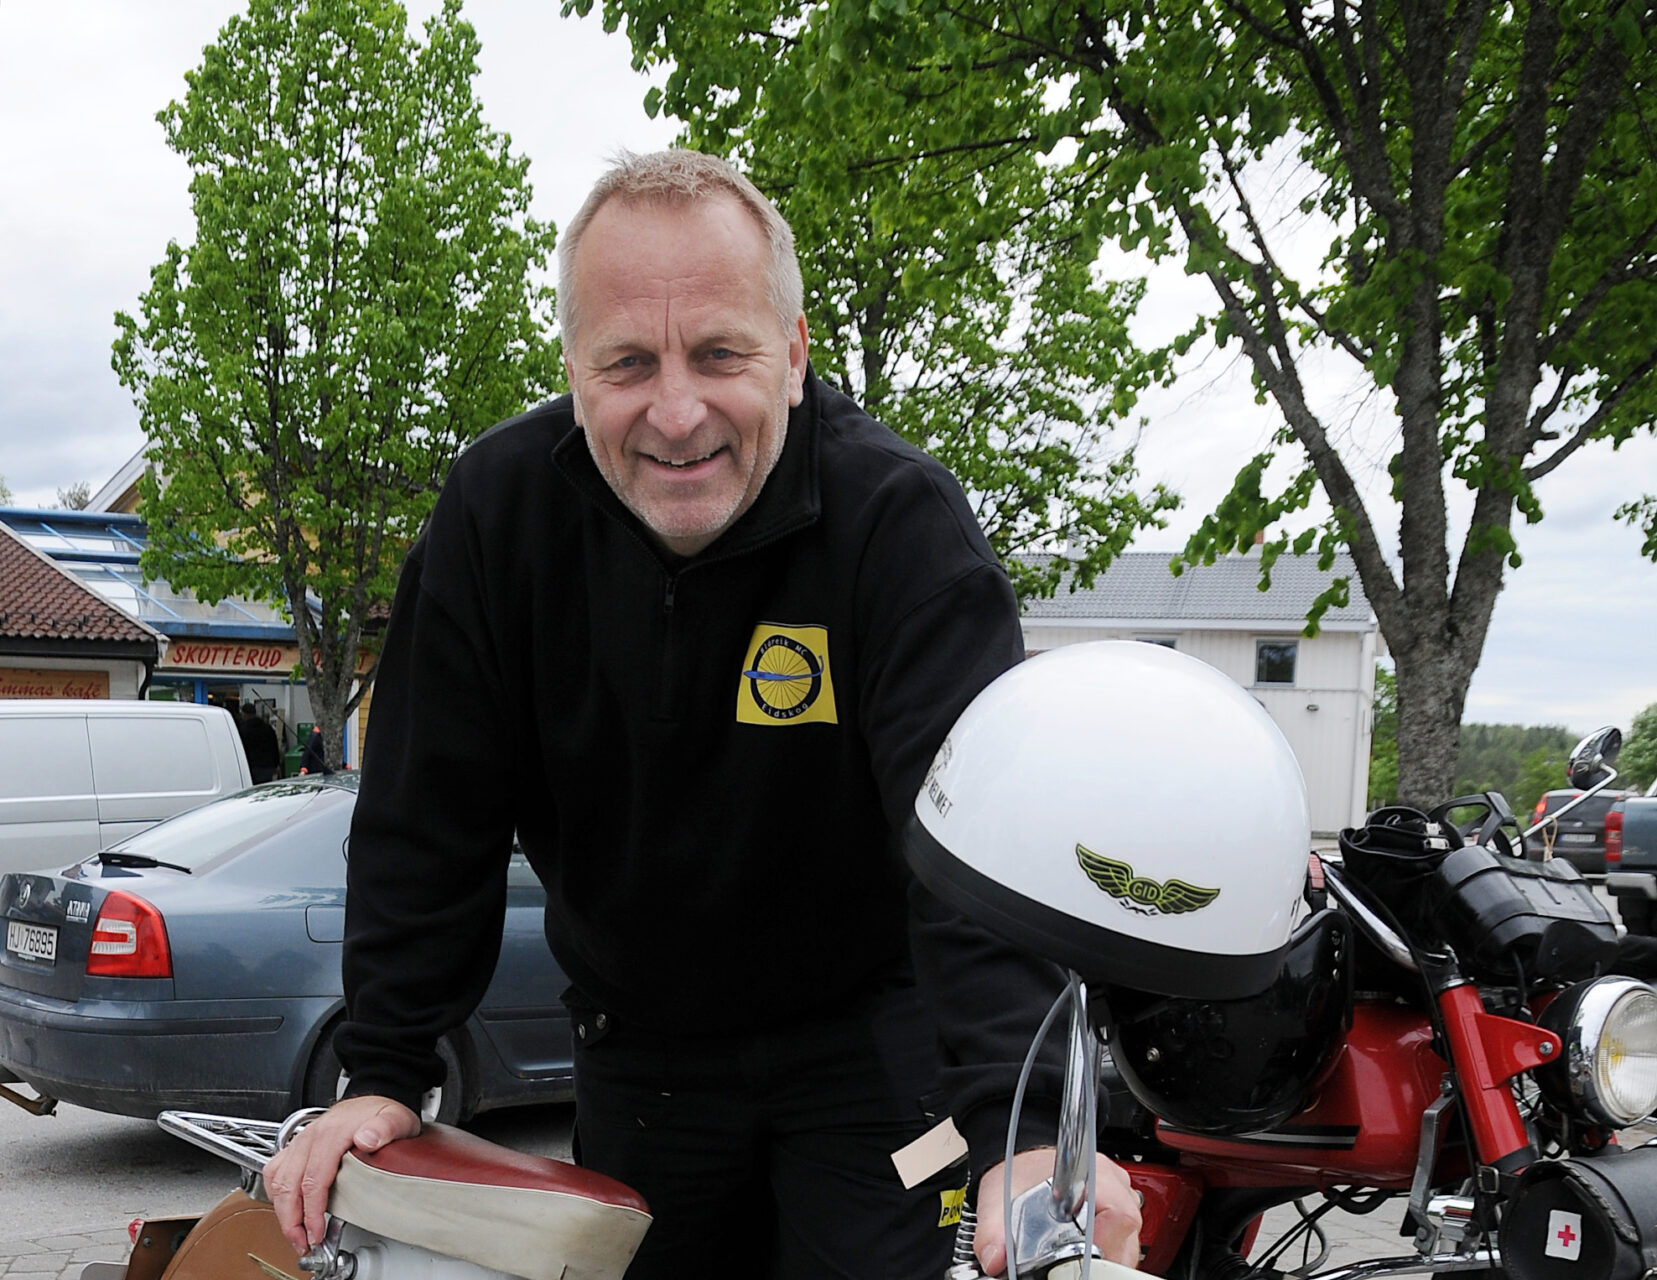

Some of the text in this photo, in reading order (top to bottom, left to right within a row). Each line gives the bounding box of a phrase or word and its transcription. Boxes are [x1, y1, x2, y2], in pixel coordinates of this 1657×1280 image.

[172, 645, 282, 668] SKOTTERUD
[795, 645, 808, 656] MC
[0, 683, 54, 698] mmas
[761, 703, 808, 718] Eidskog
[1132, 882, 1158, 901] GID
[9, 925, 54, 956] HJ 76895
